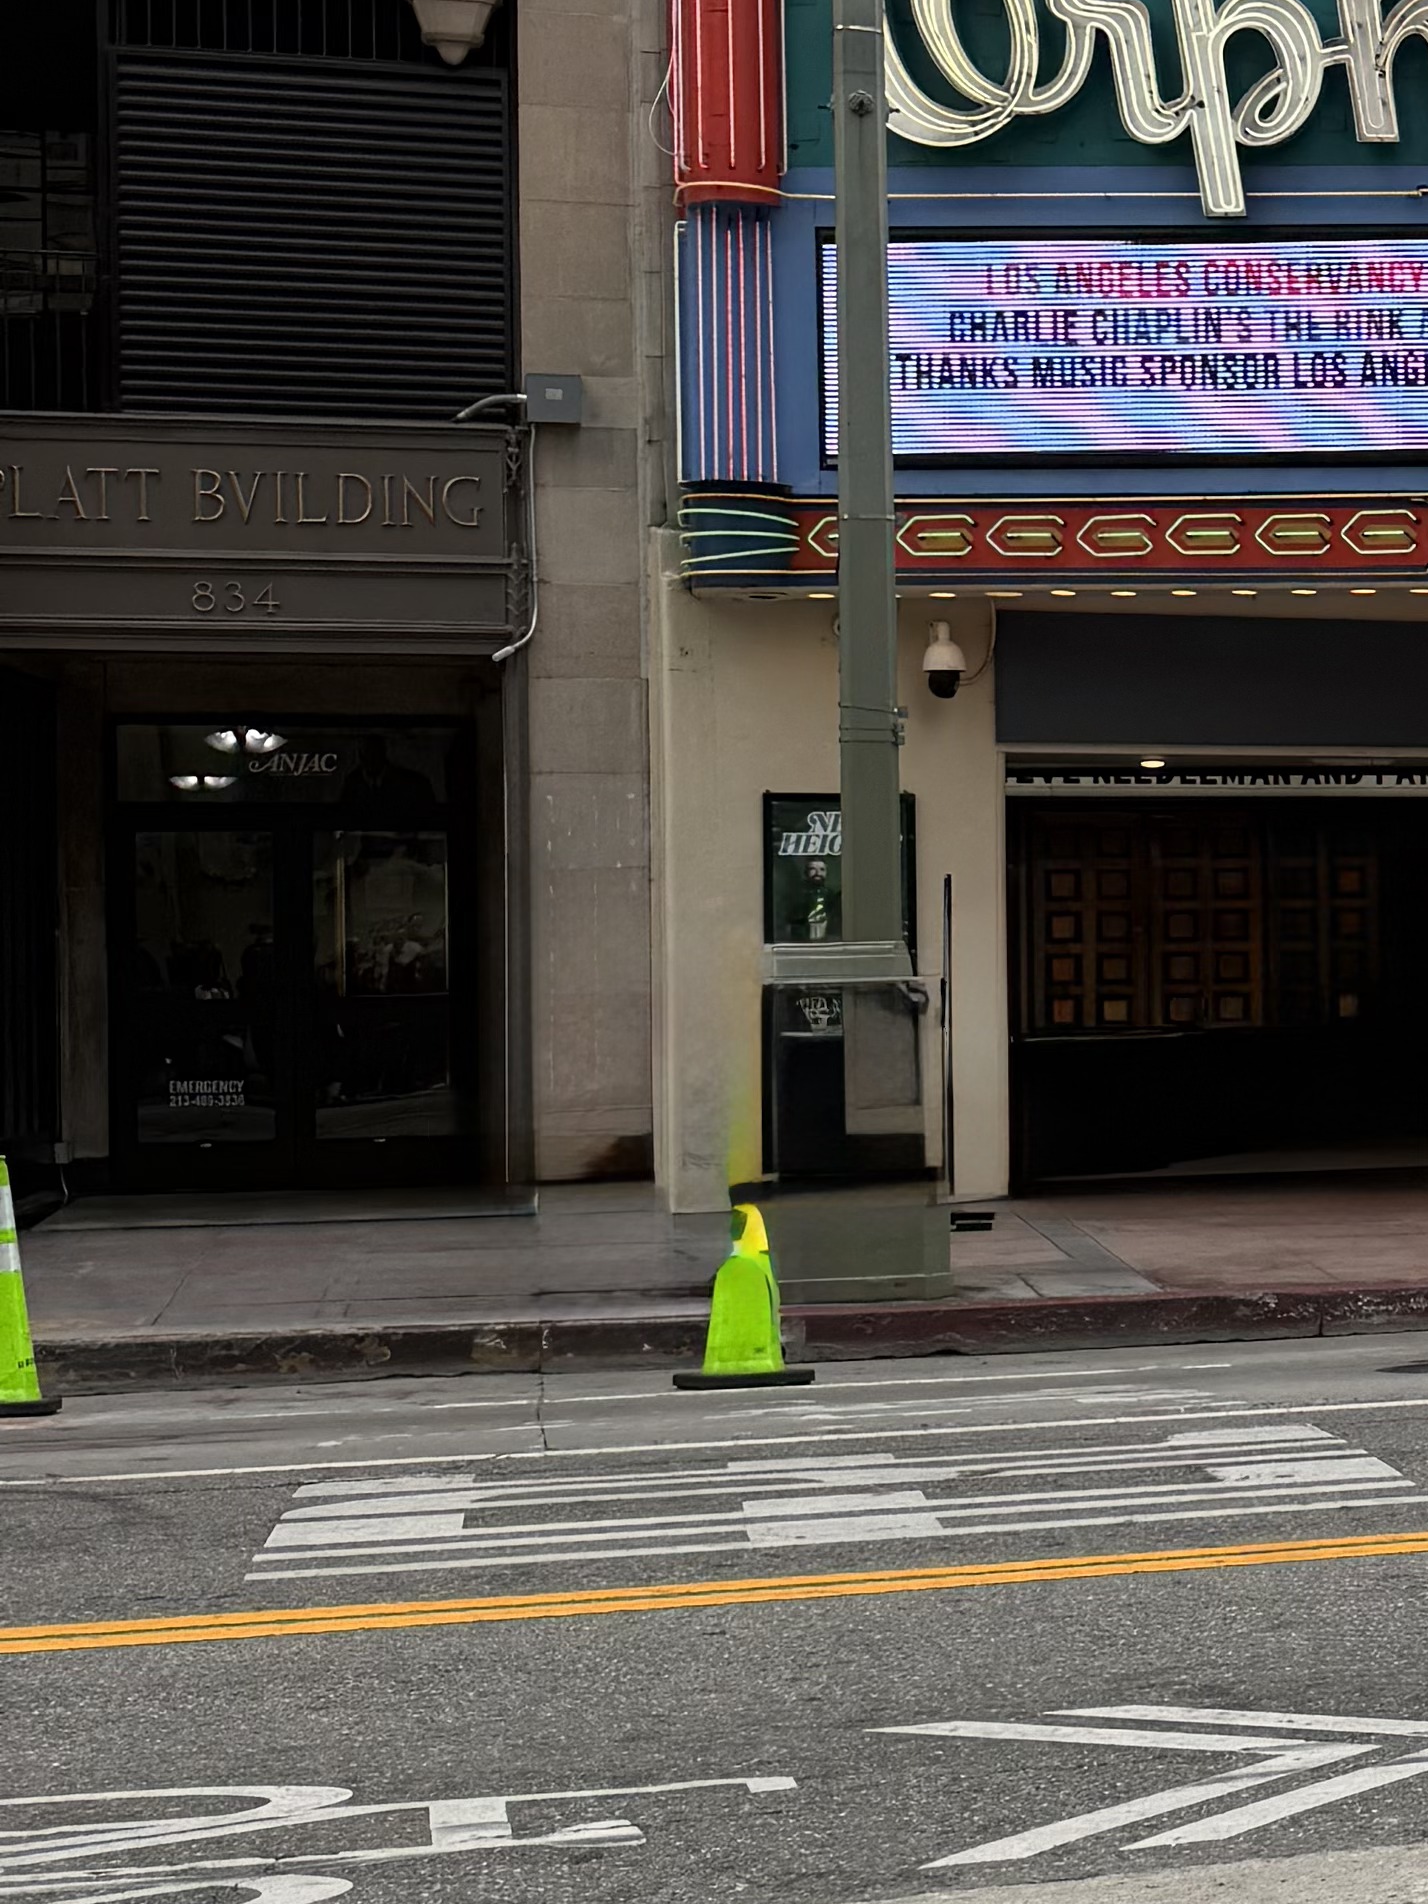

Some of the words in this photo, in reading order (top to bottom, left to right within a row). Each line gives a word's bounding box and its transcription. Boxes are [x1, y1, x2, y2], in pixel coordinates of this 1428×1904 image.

[986, 261, 1040, 296] LOS
[1054, 260, 1192, 298] ANGELES
[1204, 258, 1423, 298] CONSERVANCY
[948, 308, 1079, 346] CHARLIE
[1091, 306, 1254, 347] CHAPLIN'S
[1267, 306, 1323, 344] THE
[1334, 304, 1401, 343] RINK
[894, 352, 1020, 391] THANKS
[1031, 352, 1128, 390] MUSIC
[1139, 352, 1281, 391] SPONSOR
[1293, 351, 1348, 390] LOS
[0, 464, 160, 522] LATT
[191, 467, 484, 528] BVILDING
[192, 581, 281, 614] 834
[248, 753, 338, 776] ANJAC
[169, 1080, 245, 1094] EMERGENCY
